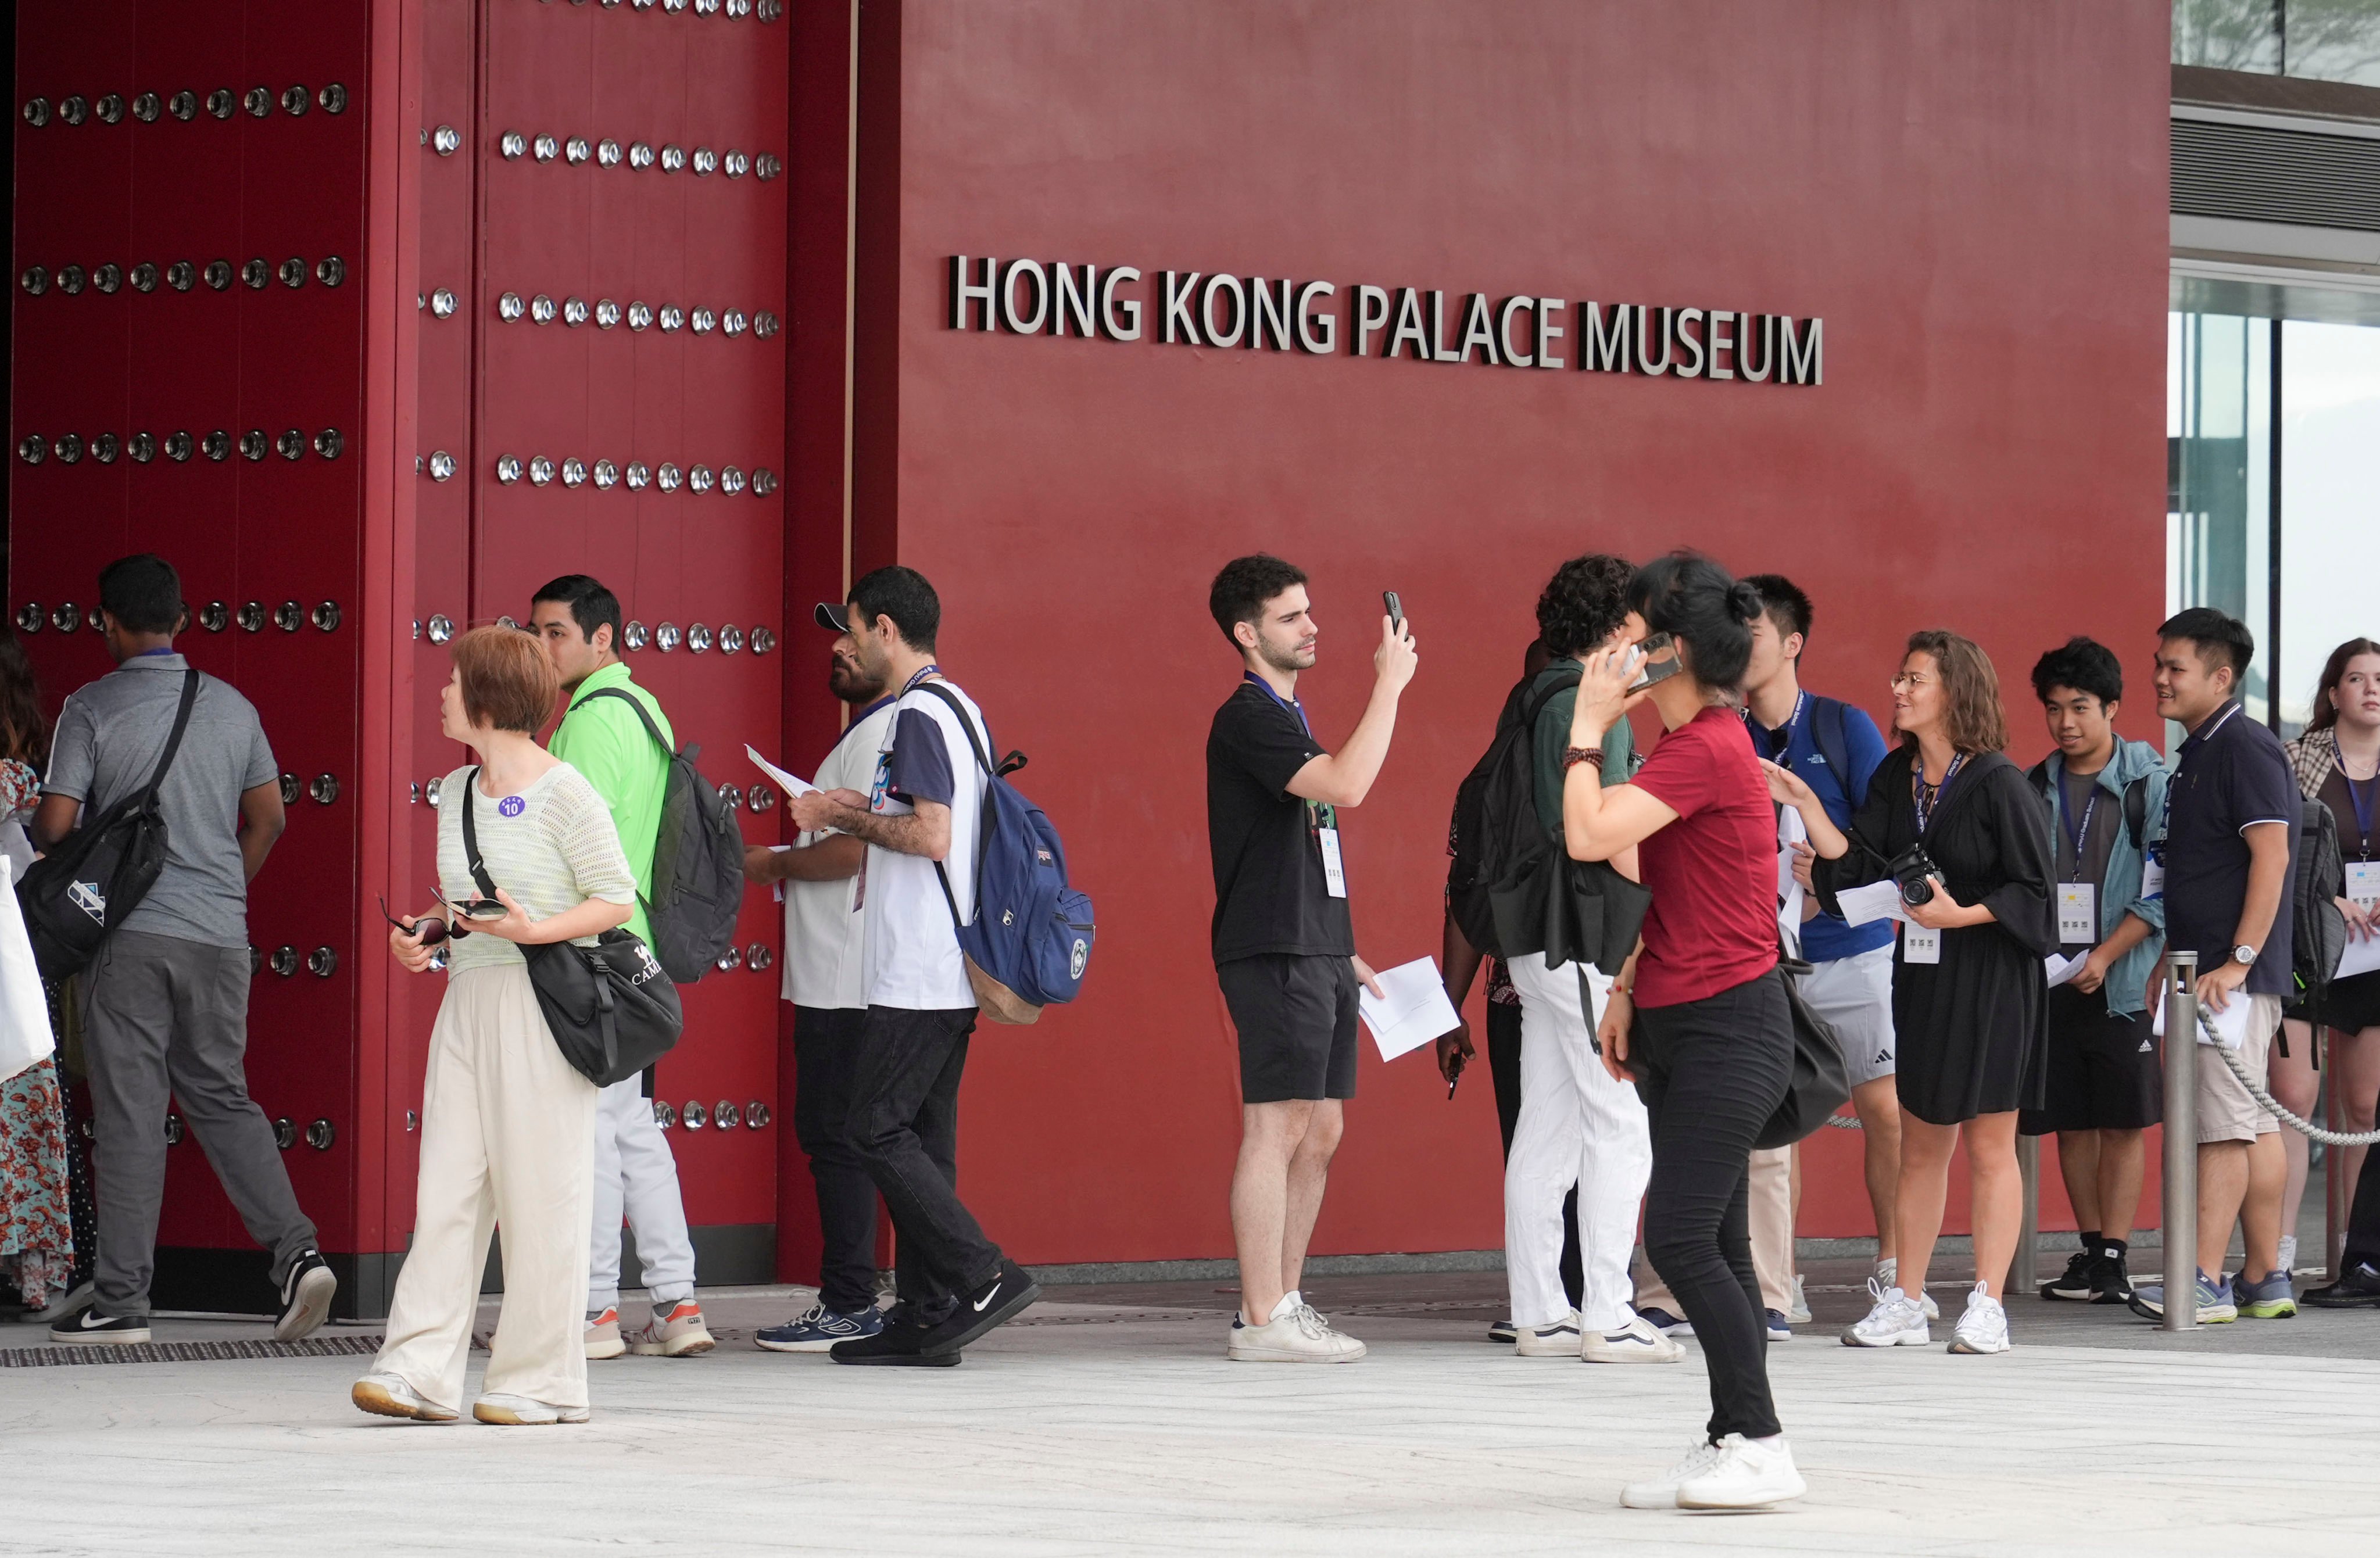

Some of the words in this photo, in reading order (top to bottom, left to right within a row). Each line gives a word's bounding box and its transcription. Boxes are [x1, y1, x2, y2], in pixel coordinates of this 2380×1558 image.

[950, 255, 1141, 341] HONG
[1158, 270, 1336, 354] KONG
[1351, 285, 1565, 370] PALACE
[1579, 301, 1823, 386] MUSEUM
[914, 668, 929, 680] PolyU
[1947, 760, 1960, 777] School
[504, 803, 518, 815] 10
[818, 1315, 833, 1326] FILA
